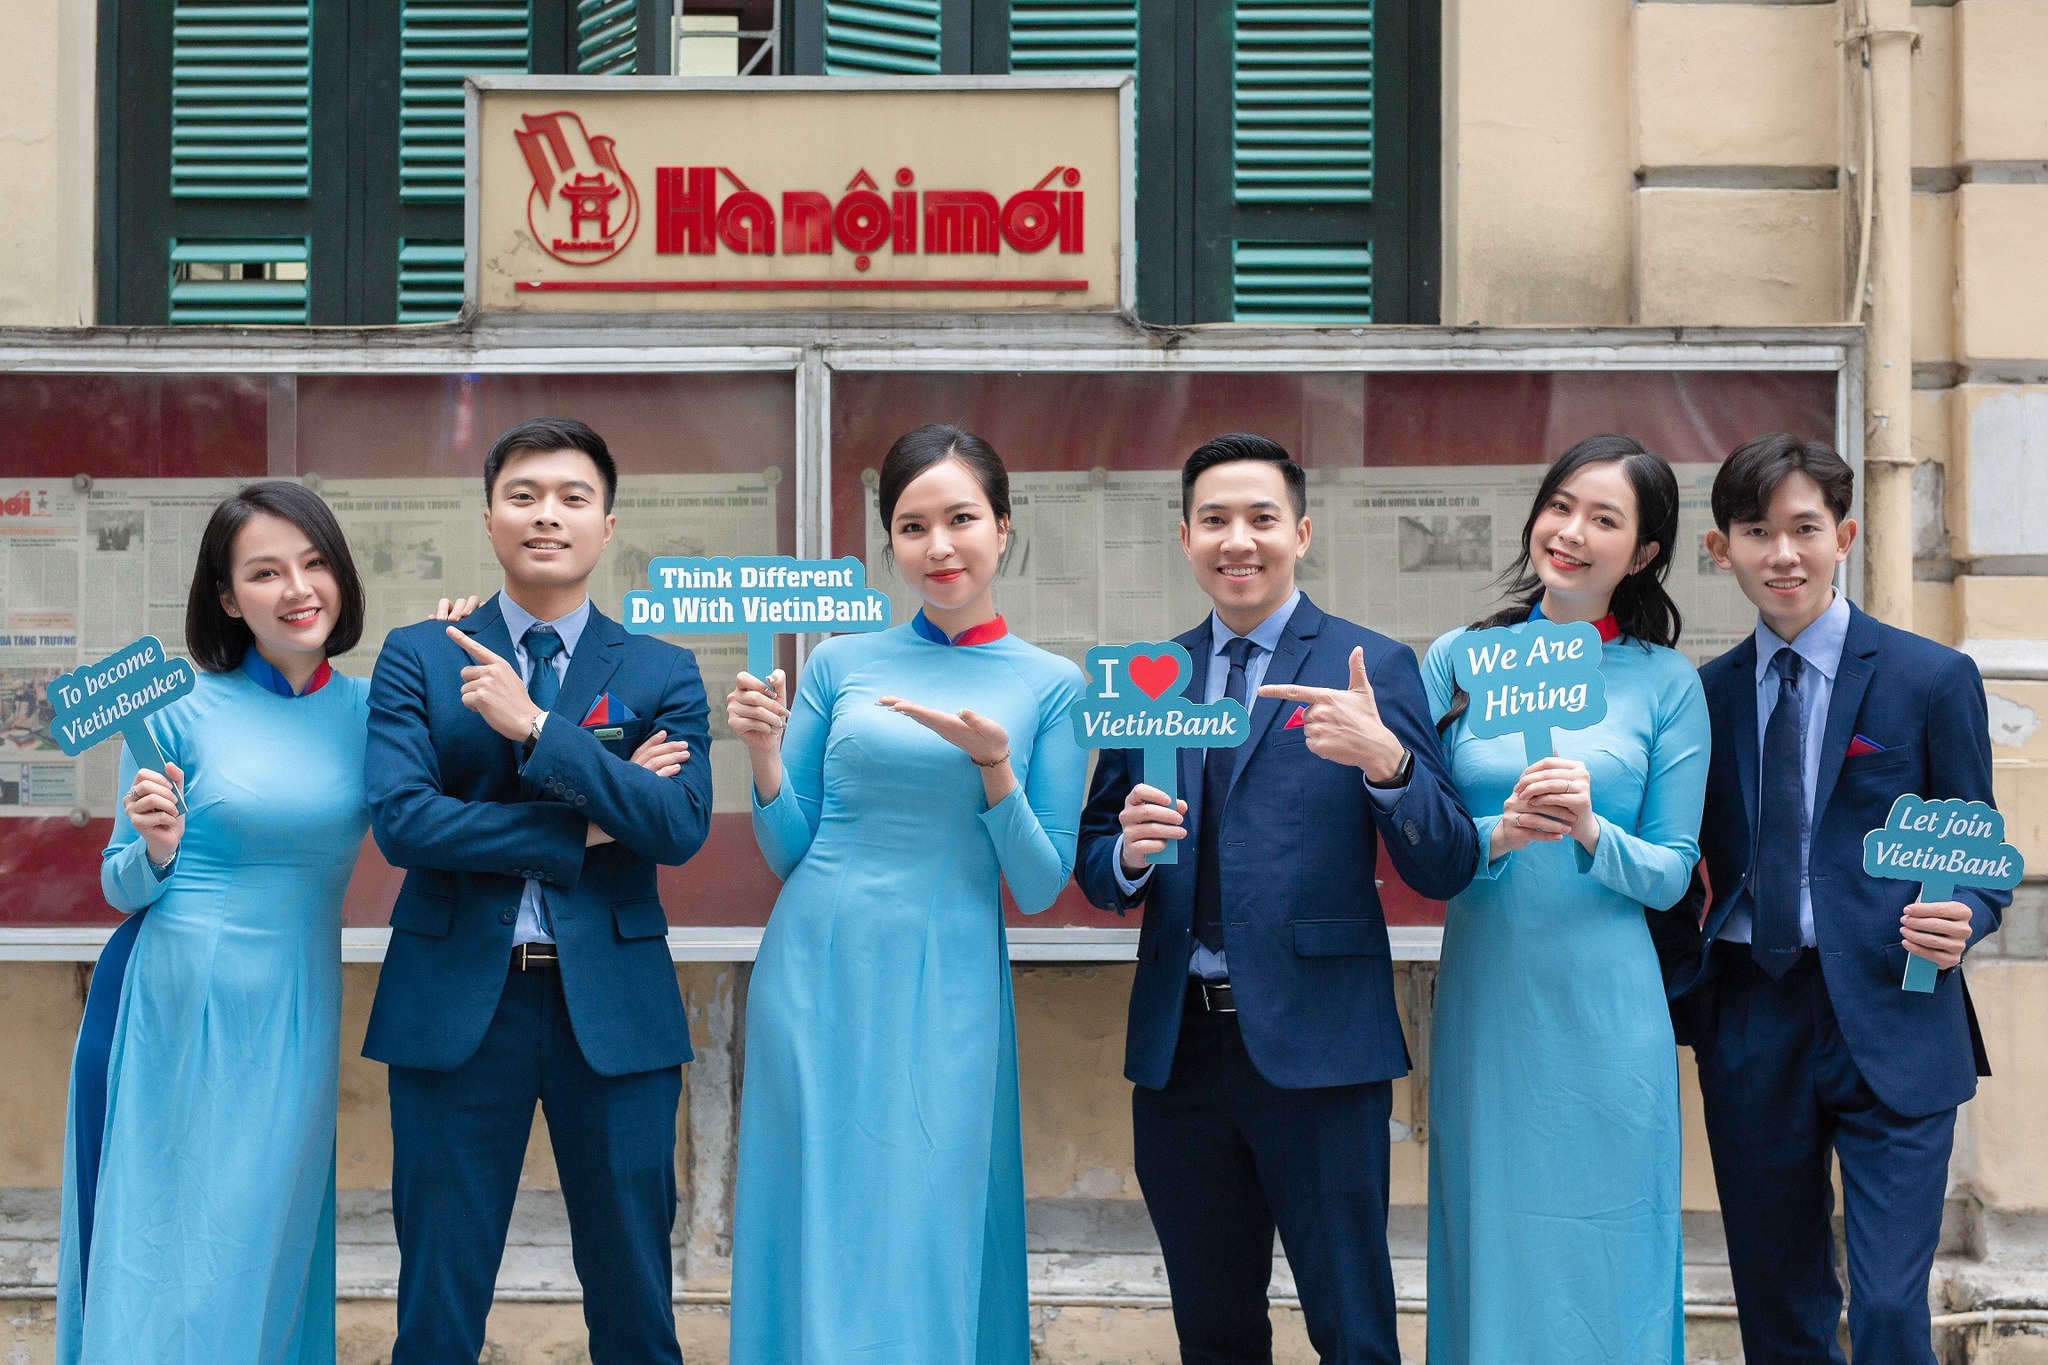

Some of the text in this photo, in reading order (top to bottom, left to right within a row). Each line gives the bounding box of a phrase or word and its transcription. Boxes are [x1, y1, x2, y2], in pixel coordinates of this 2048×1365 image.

[0, 489, 31, 517] ới
[660, 565, 854, 589] Think Different
[632, 595, 883, 624] Do With VietinBank
[1467, 636, 1584, 676] We Are
[59, 647, 156, 709] To become
[1098, 659, 1120, 699] I
[62, 669, 187, 745] VietinBanker
[1485, 682, 1588, 722] Hiring
[1083, 710, 1237, 737] VietinBank
[1900, 806, 1992, 839] Let join
[1877, 842, 2012, 878] VietinBank
